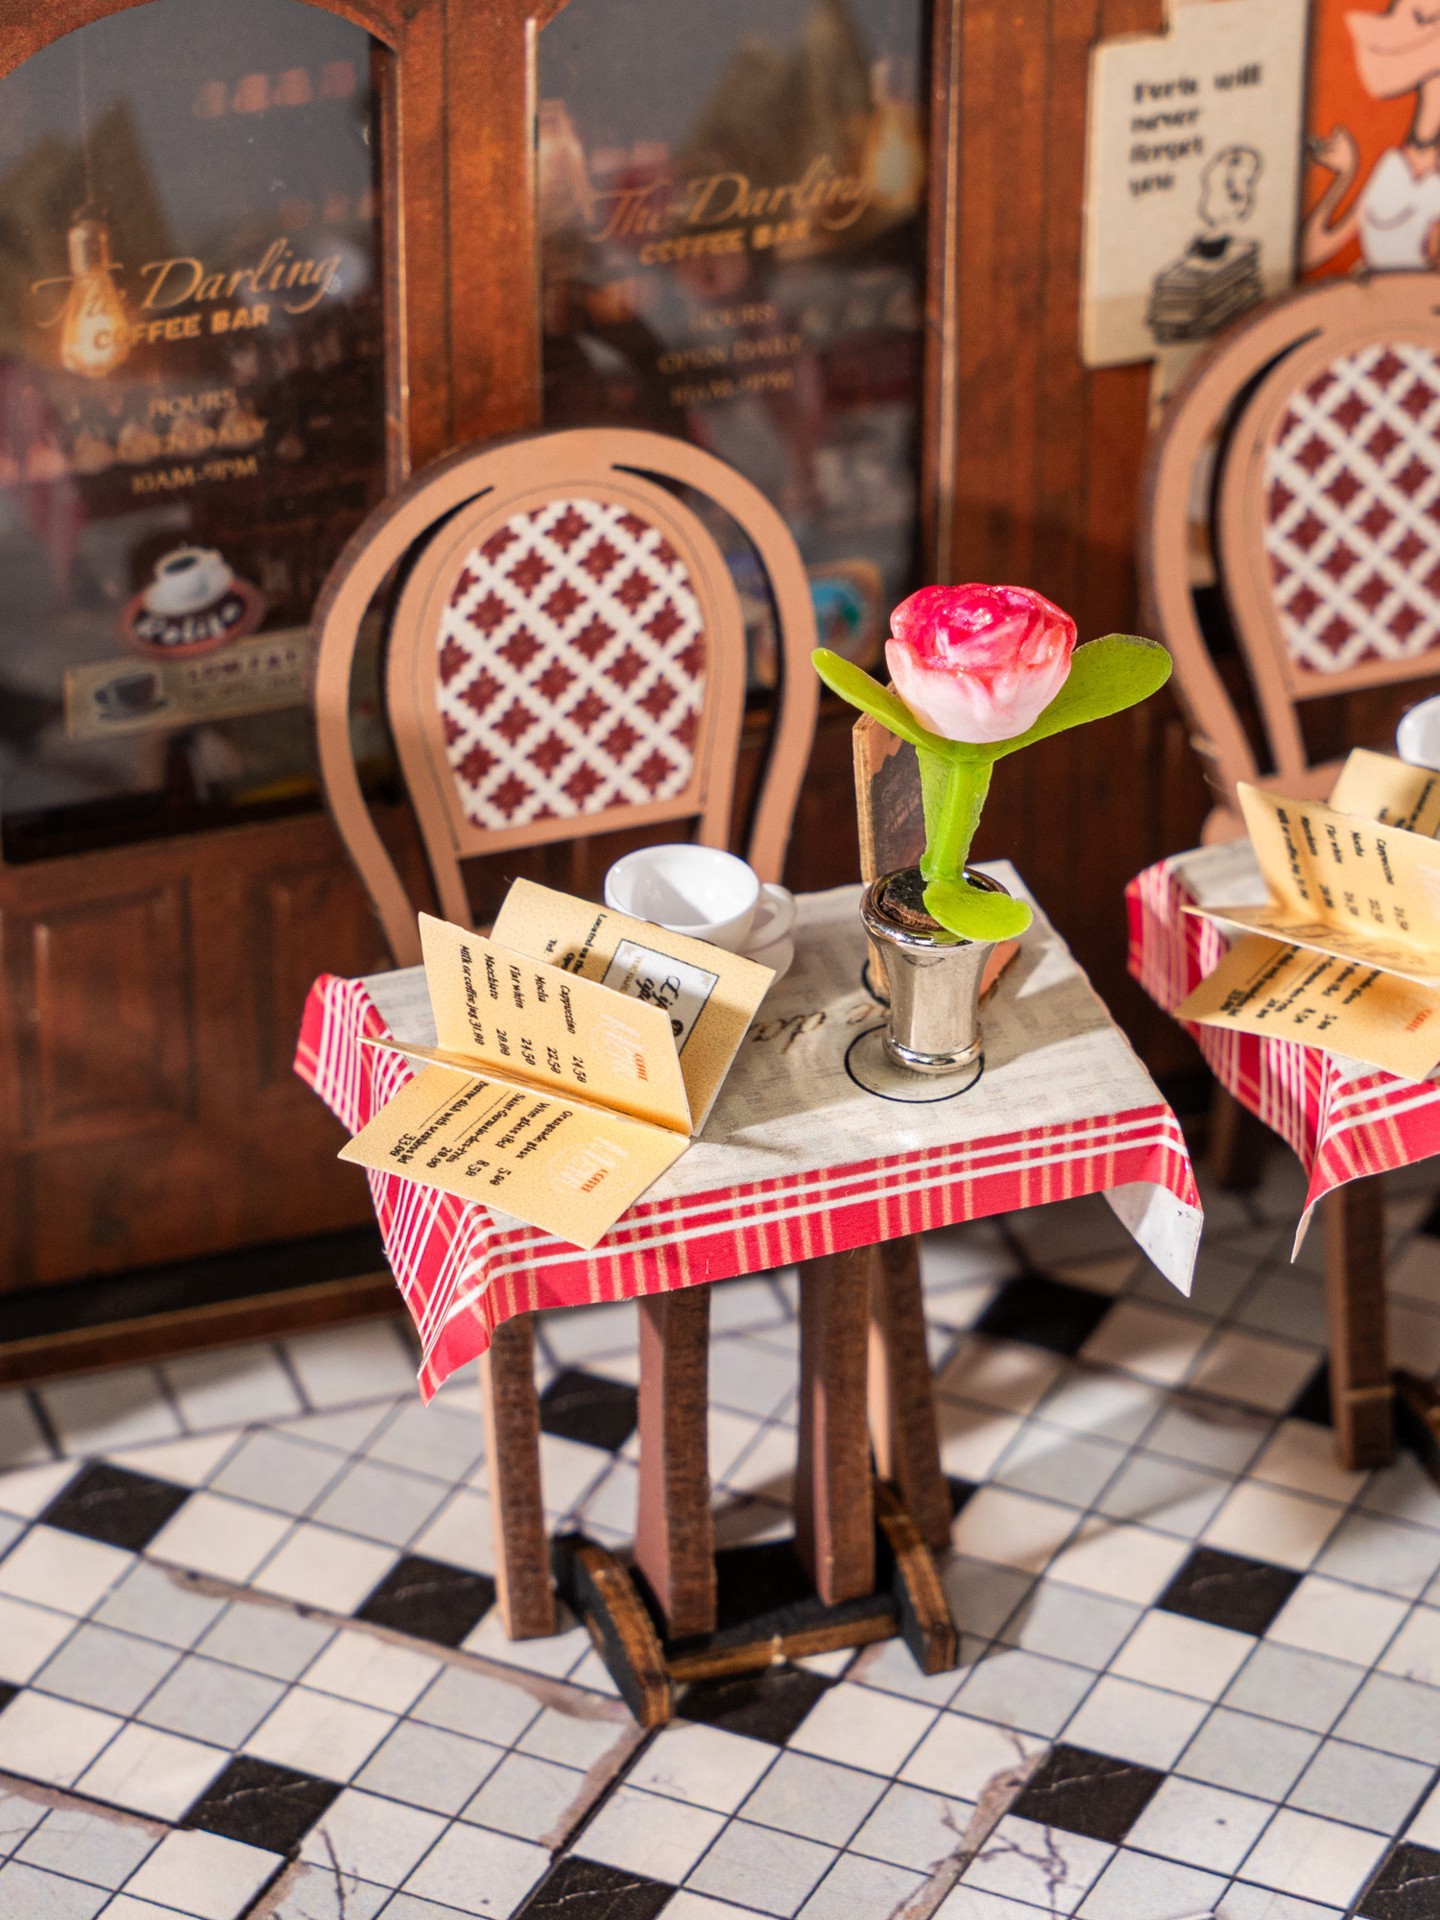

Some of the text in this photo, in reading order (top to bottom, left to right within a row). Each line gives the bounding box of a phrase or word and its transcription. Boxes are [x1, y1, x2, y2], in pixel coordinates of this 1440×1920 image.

[139, 238, 342, 314] Darling
[210, 304, 271, 335] BAR
[460, 945, 473, 963] Milk
[462, 965, 471, 976] or
[463, 976, 477, 1002] coffee
[484, 953, 511, 1057] Macchiato 20.00
[559, 984, 576, 1035] Cappuccino
[468, 1018, 485, 1046] 31.00
[535, 974, 561, 1074] Mocha 22.50
[521, 1037, 536, 1066] 24.50
[527, 1102, 550, 1119] Wine
[509, 1116, 531, 1135] glass
[489, 1110, 573, 1186] Orangeade glass 5.00
[465, 1159, 490, 1177] 8.50
